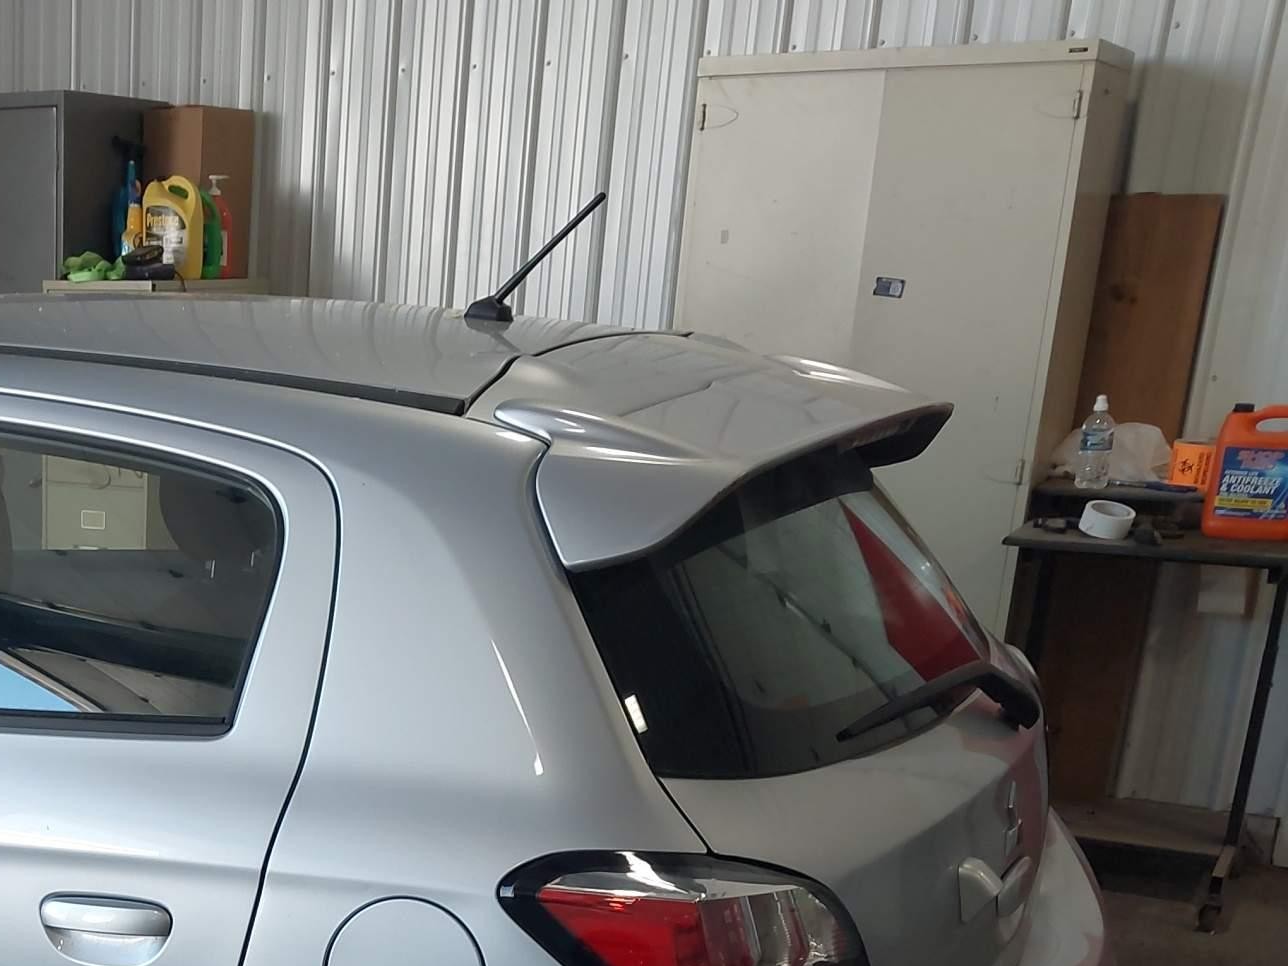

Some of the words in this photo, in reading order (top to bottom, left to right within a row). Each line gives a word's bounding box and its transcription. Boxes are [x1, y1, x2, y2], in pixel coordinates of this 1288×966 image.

[1221, 474, 1283, 487] ANTIFREEZE
[1220, 483, 1228, 492] &
[1230, 484, 1279, 496] COOLANT
